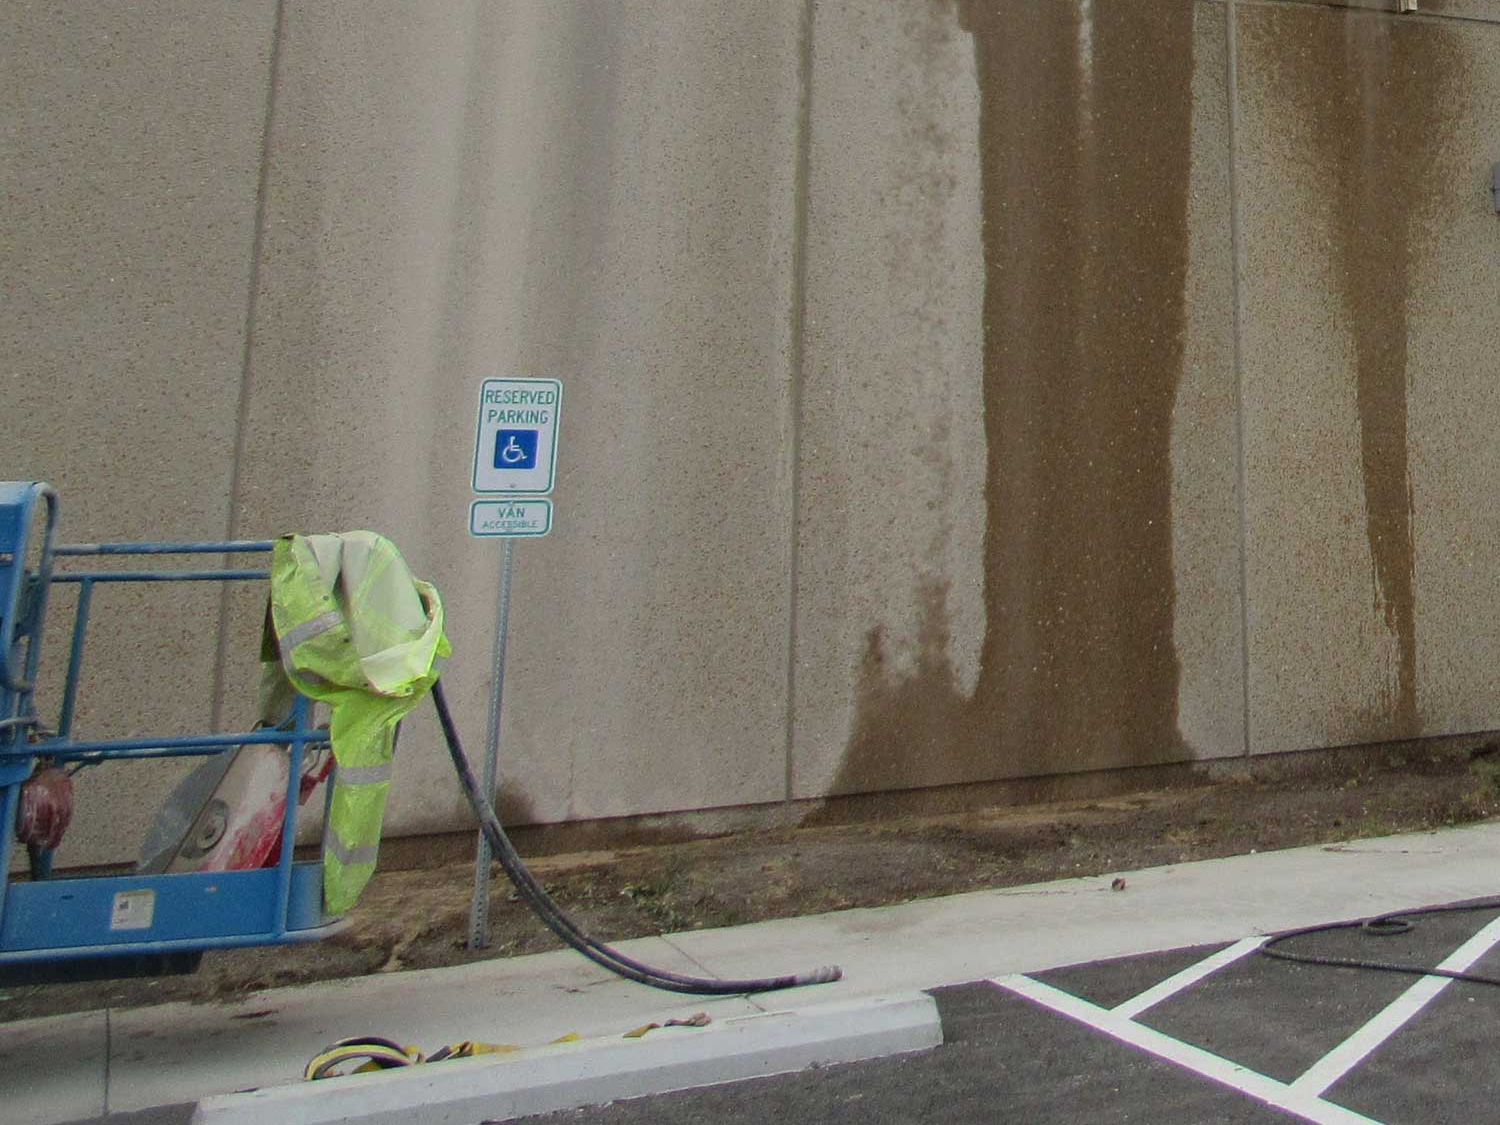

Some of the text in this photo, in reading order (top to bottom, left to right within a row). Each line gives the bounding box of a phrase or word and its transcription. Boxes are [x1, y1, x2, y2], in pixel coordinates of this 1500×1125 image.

[485, 390, 556, 404] RESERVED
[487, 409, 549, 424] PARKING
[498, 507, 525, 518] VAN
